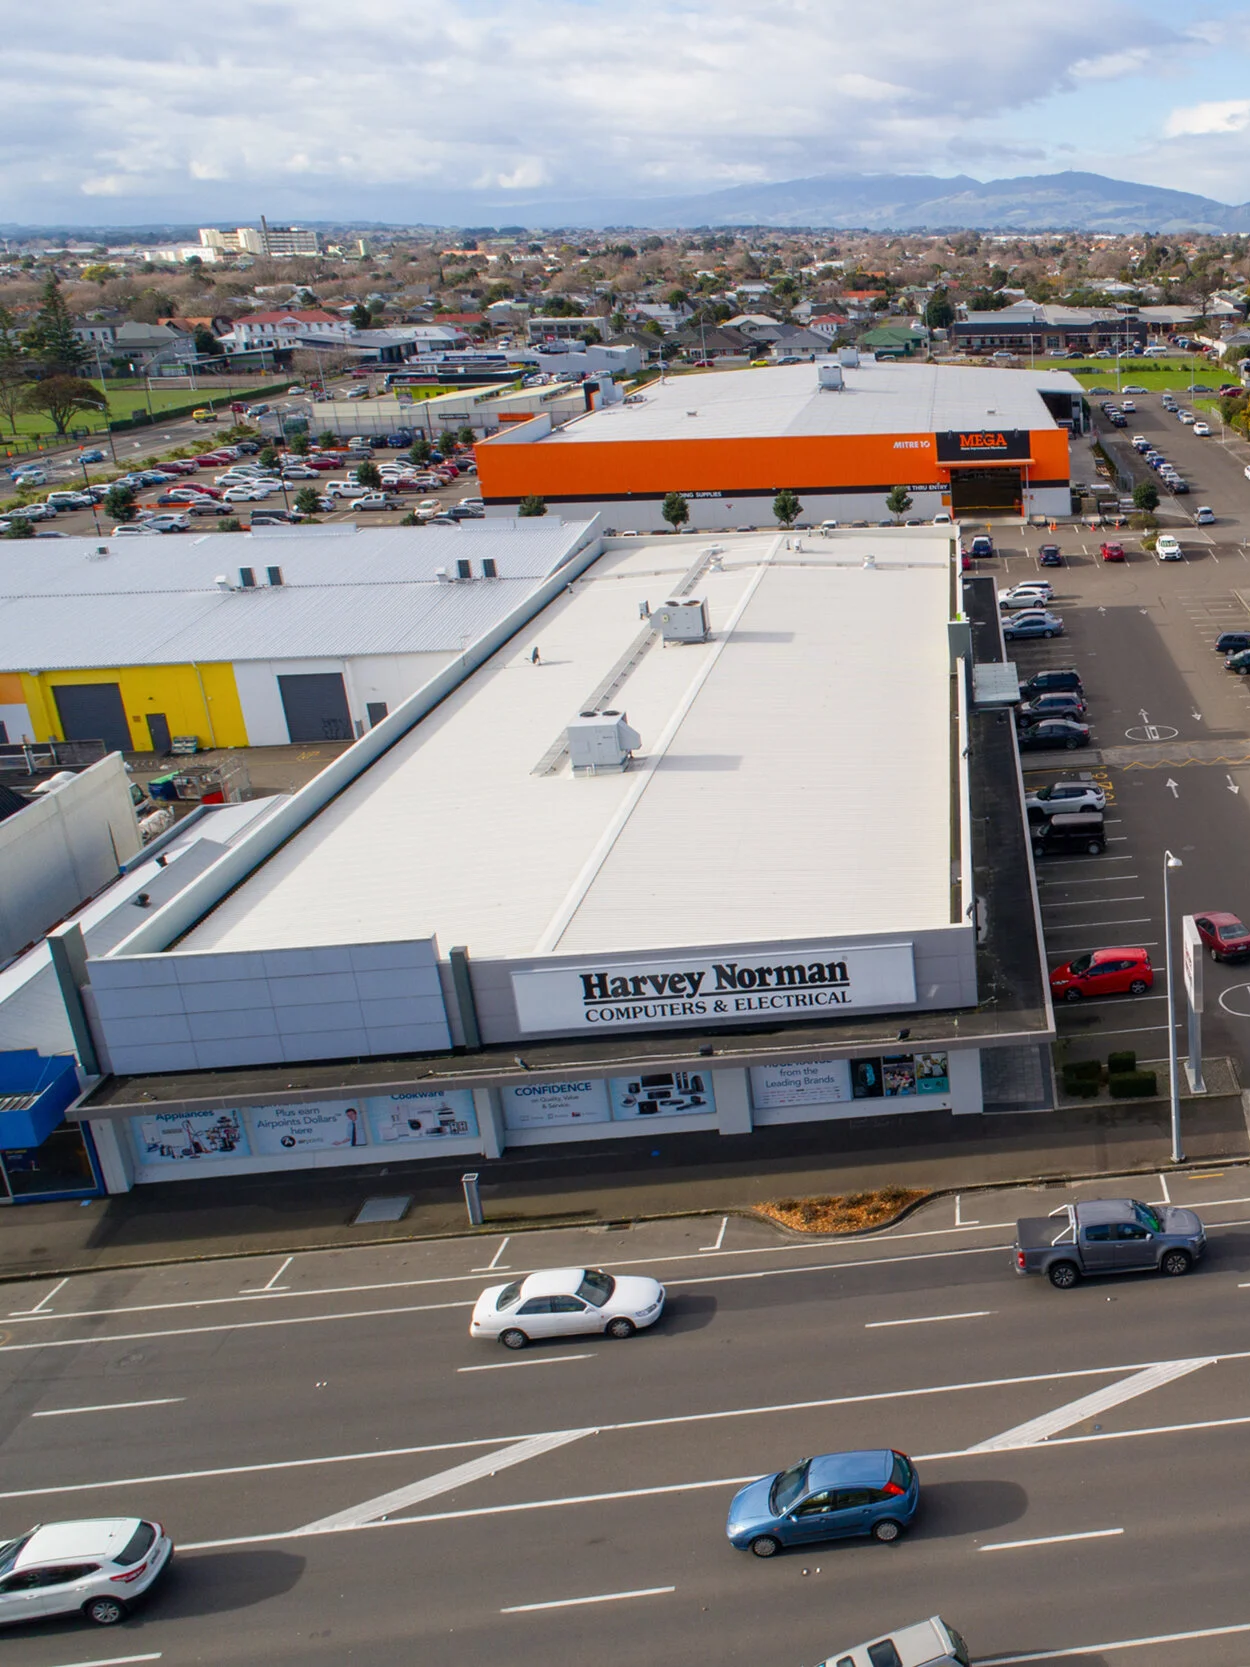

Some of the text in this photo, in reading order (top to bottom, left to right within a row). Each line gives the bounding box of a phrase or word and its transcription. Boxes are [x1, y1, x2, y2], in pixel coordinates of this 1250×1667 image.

[893, 441, 919, 449] MITRE
[960, 433, 1008, 447] MEGA
[579, 961, 850, 1000] Harvey Norman
[585, 991, 852, 1023] COMPUTERS & ELECTRICAL
[779, 1067, 819, 1077] from the
[514, 1082, 593, 1096] CONFIDENCE
[765, 1076, 836, 1090] Leading Brands
[155, 1108, 215, 1123] Appliances
[275, 1106, 320, 1118] Plus earn
[257, 1118, 301, 1129] Airpoints
[290, 1126, 313, 1136] here
